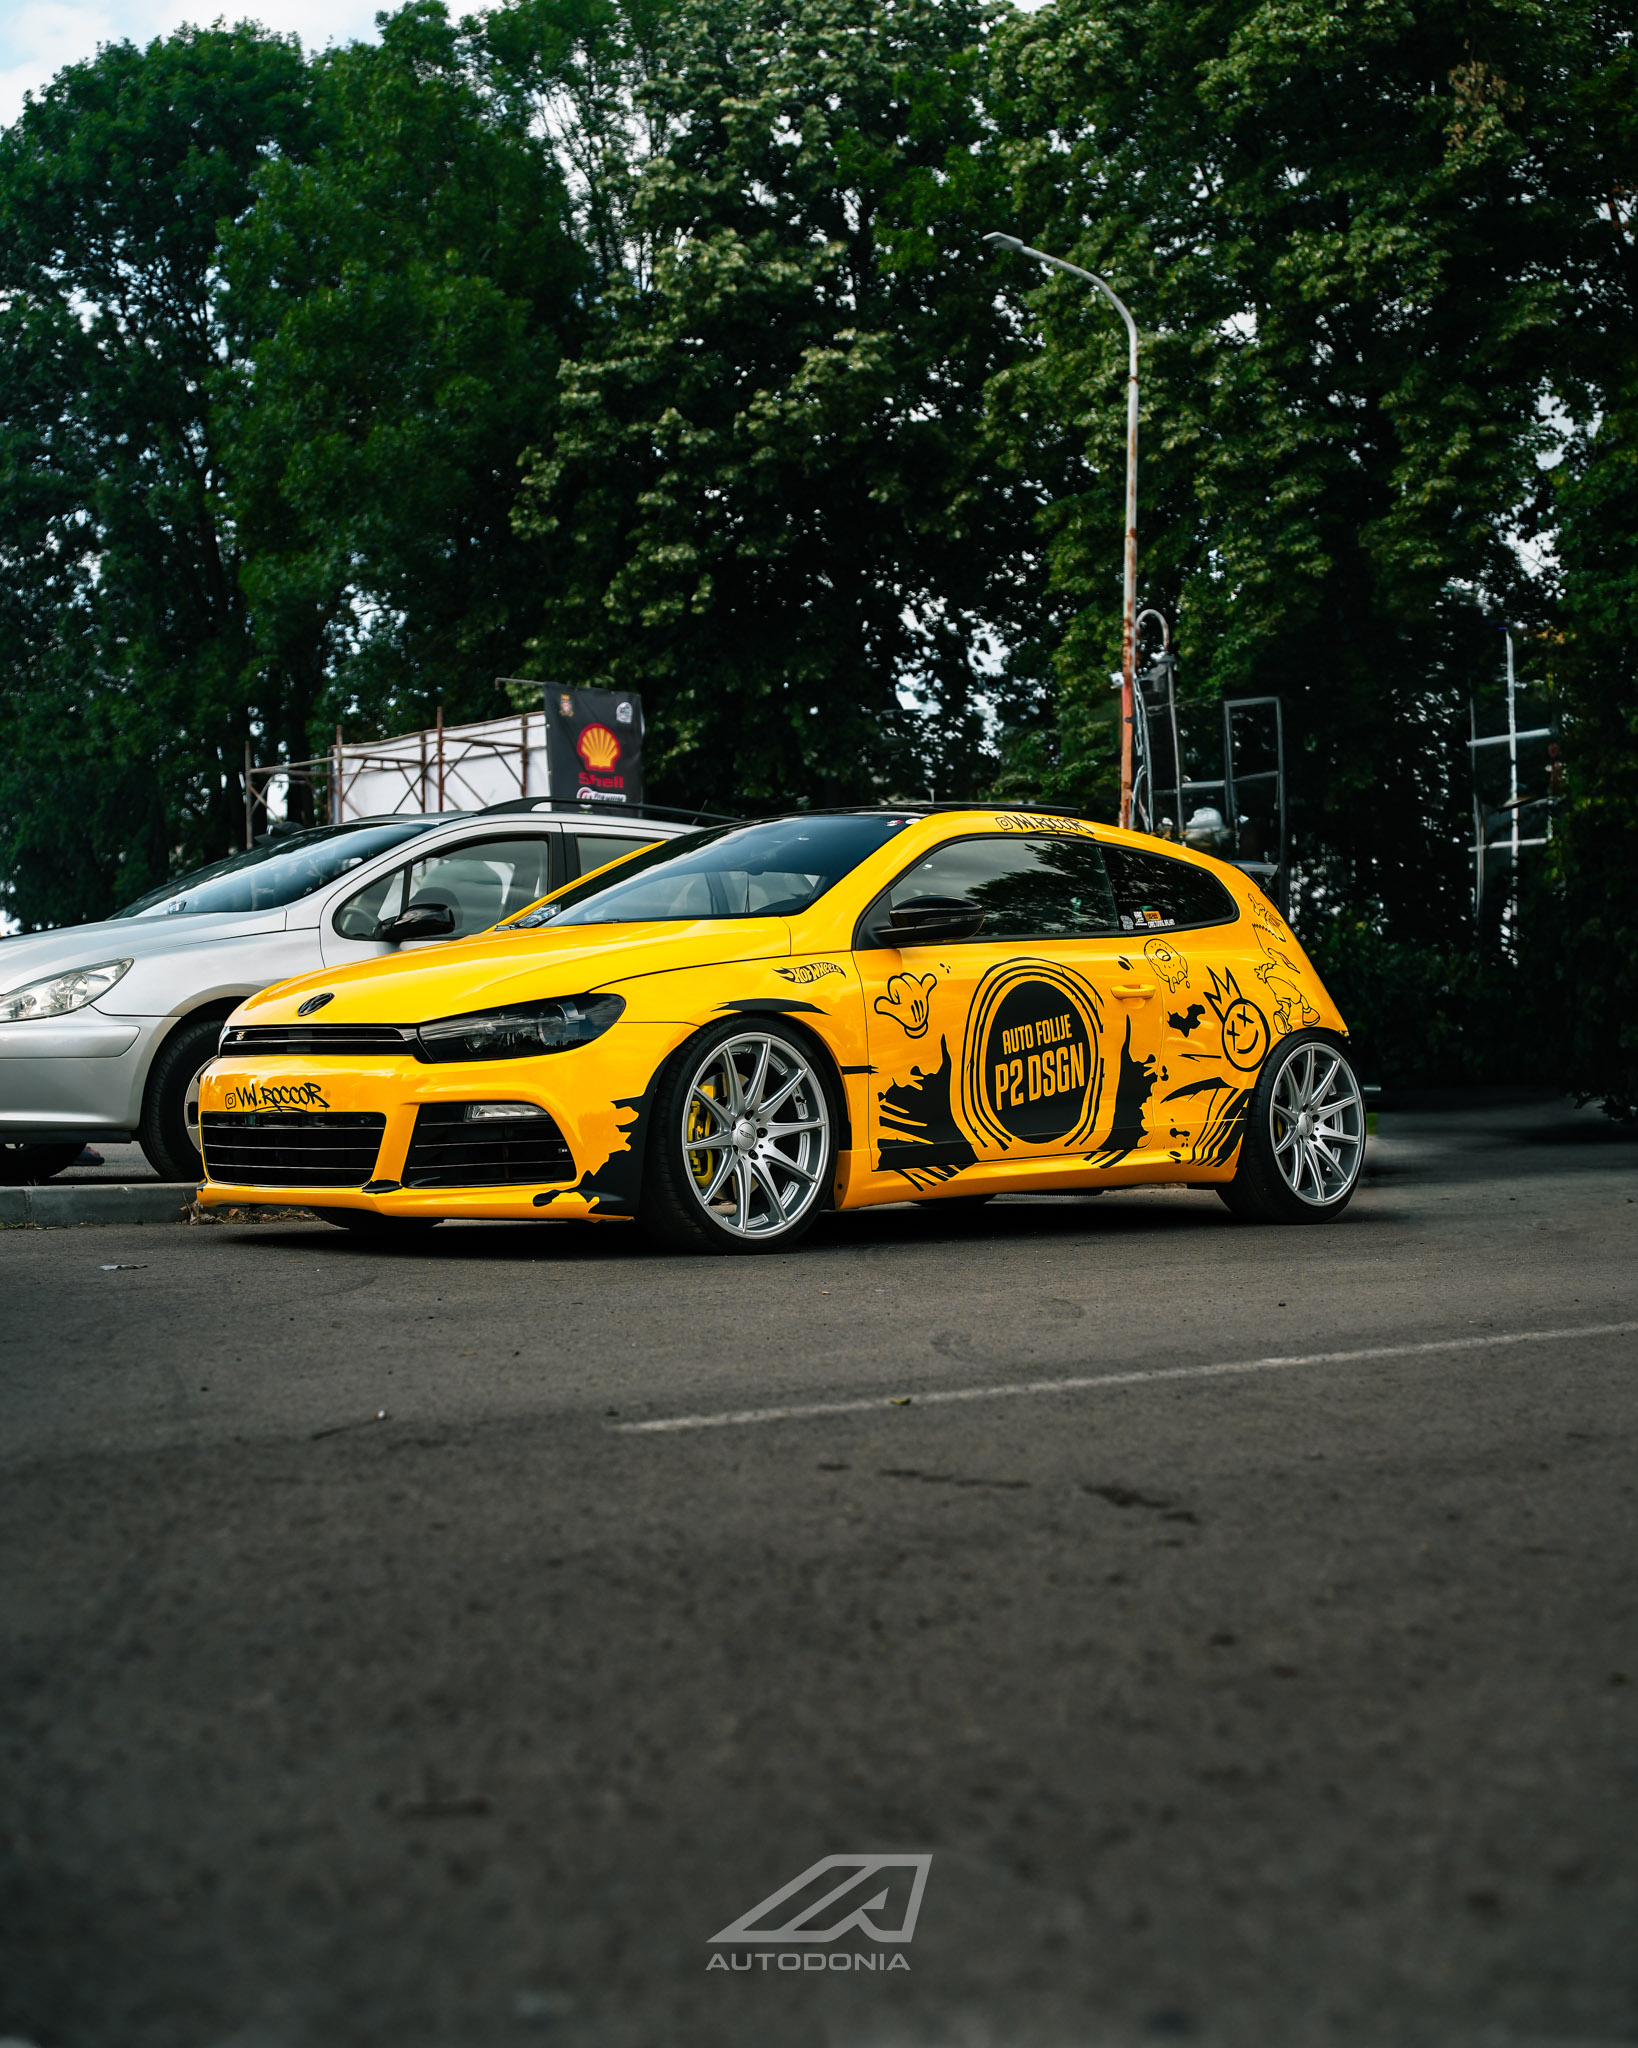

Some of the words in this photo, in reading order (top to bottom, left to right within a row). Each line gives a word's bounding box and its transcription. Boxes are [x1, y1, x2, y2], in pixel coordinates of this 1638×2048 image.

[578, 771, 624, 788] Shell
[1002, 1024, 1034, 1055] AUTO
[1035, 1014, 1072, 1046] FOLIJE
[995, 1058, 1024, 1111] P2
[1027, 1042, 1085, 1102] DSGN
